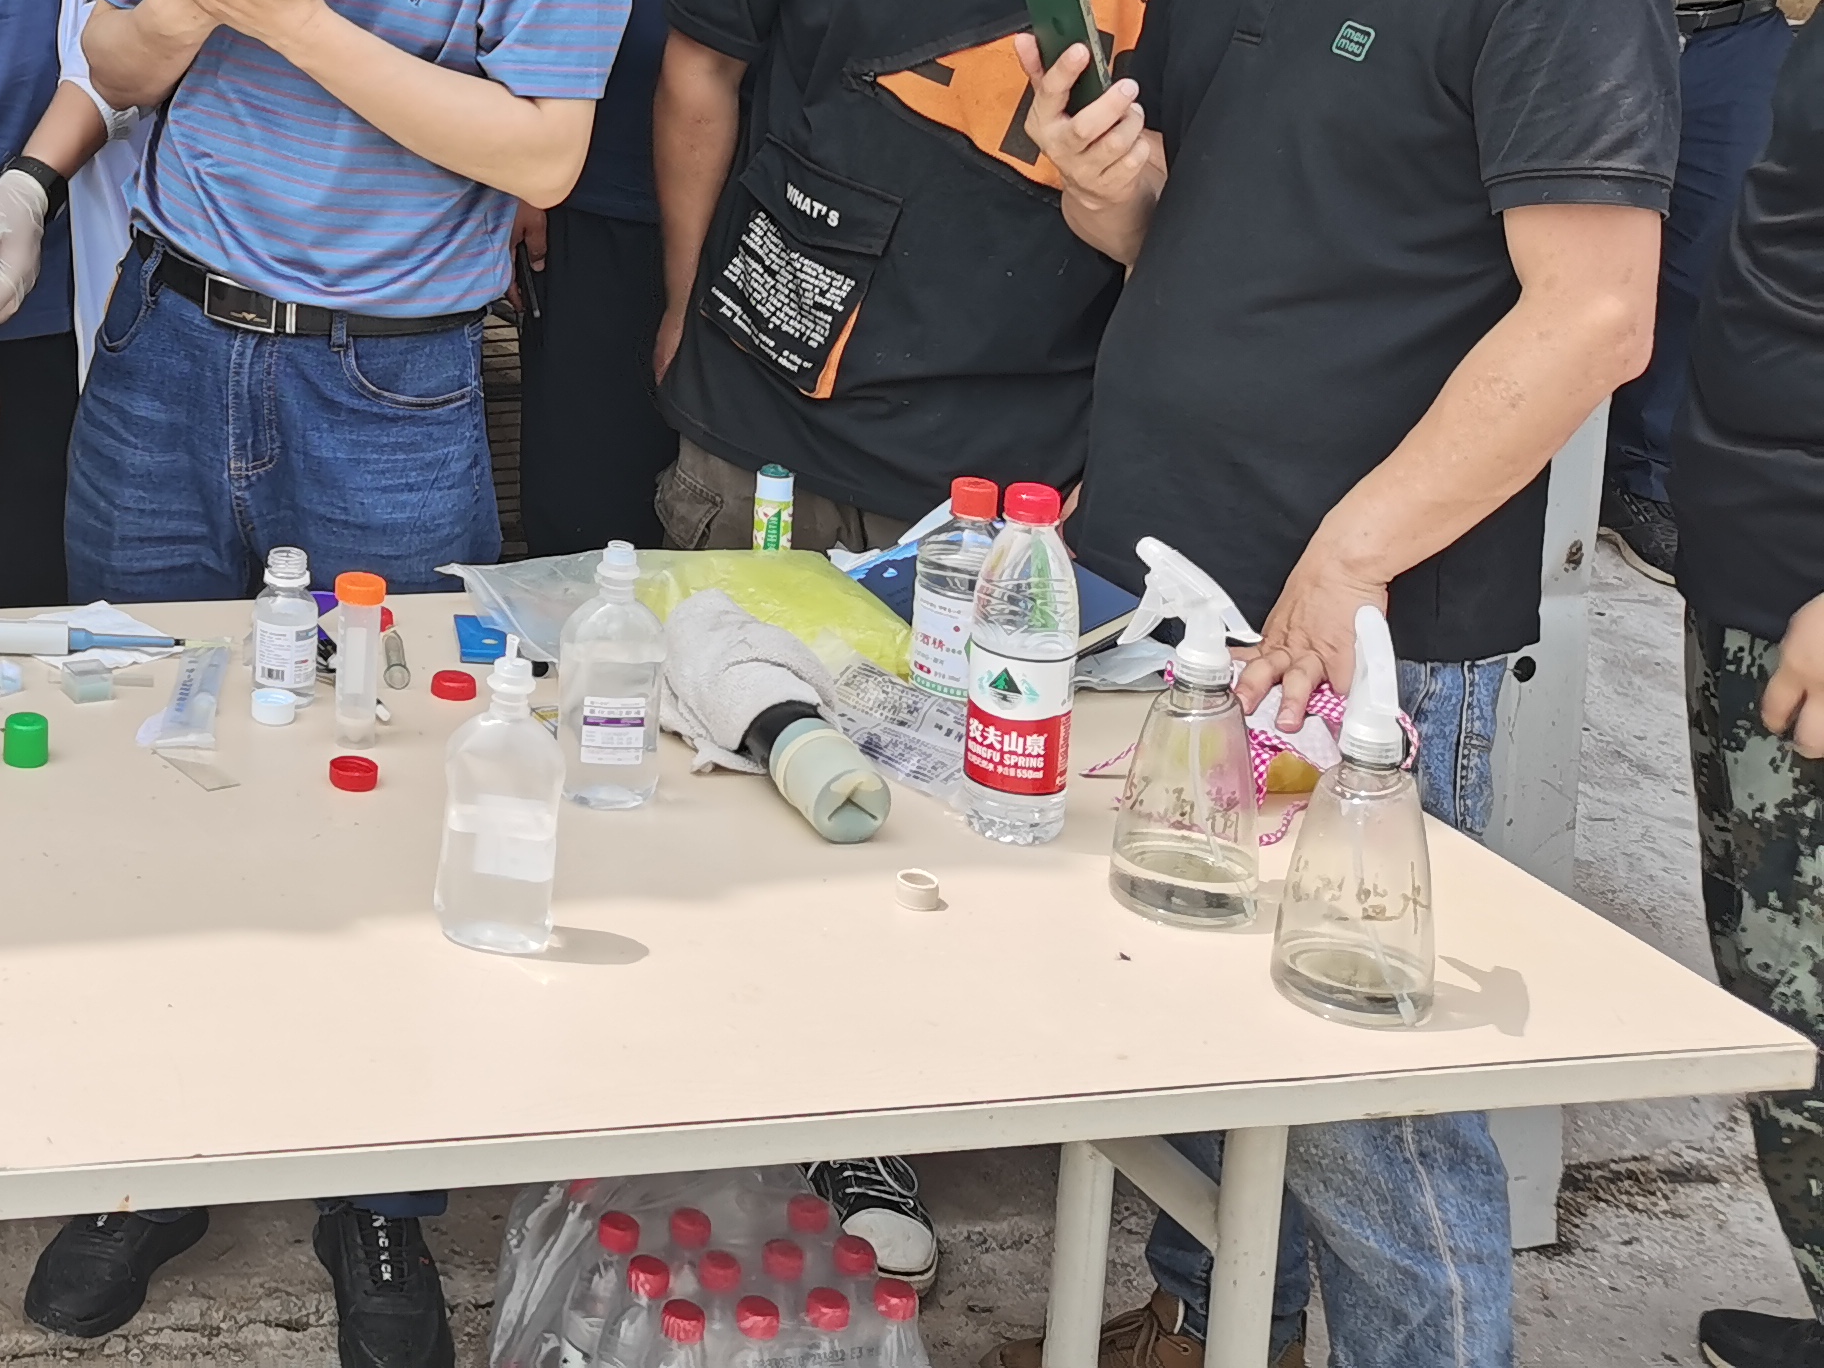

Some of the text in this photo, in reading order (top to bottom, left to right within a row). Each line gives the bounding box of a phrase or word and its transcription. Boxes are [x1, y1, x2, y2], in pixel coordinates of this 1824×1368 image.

[785, 182, 840, 228] WHAT'S
[969, 717, 1046, 756] 农夫山泉
[1003, 753, 1045, 769] SPRING
